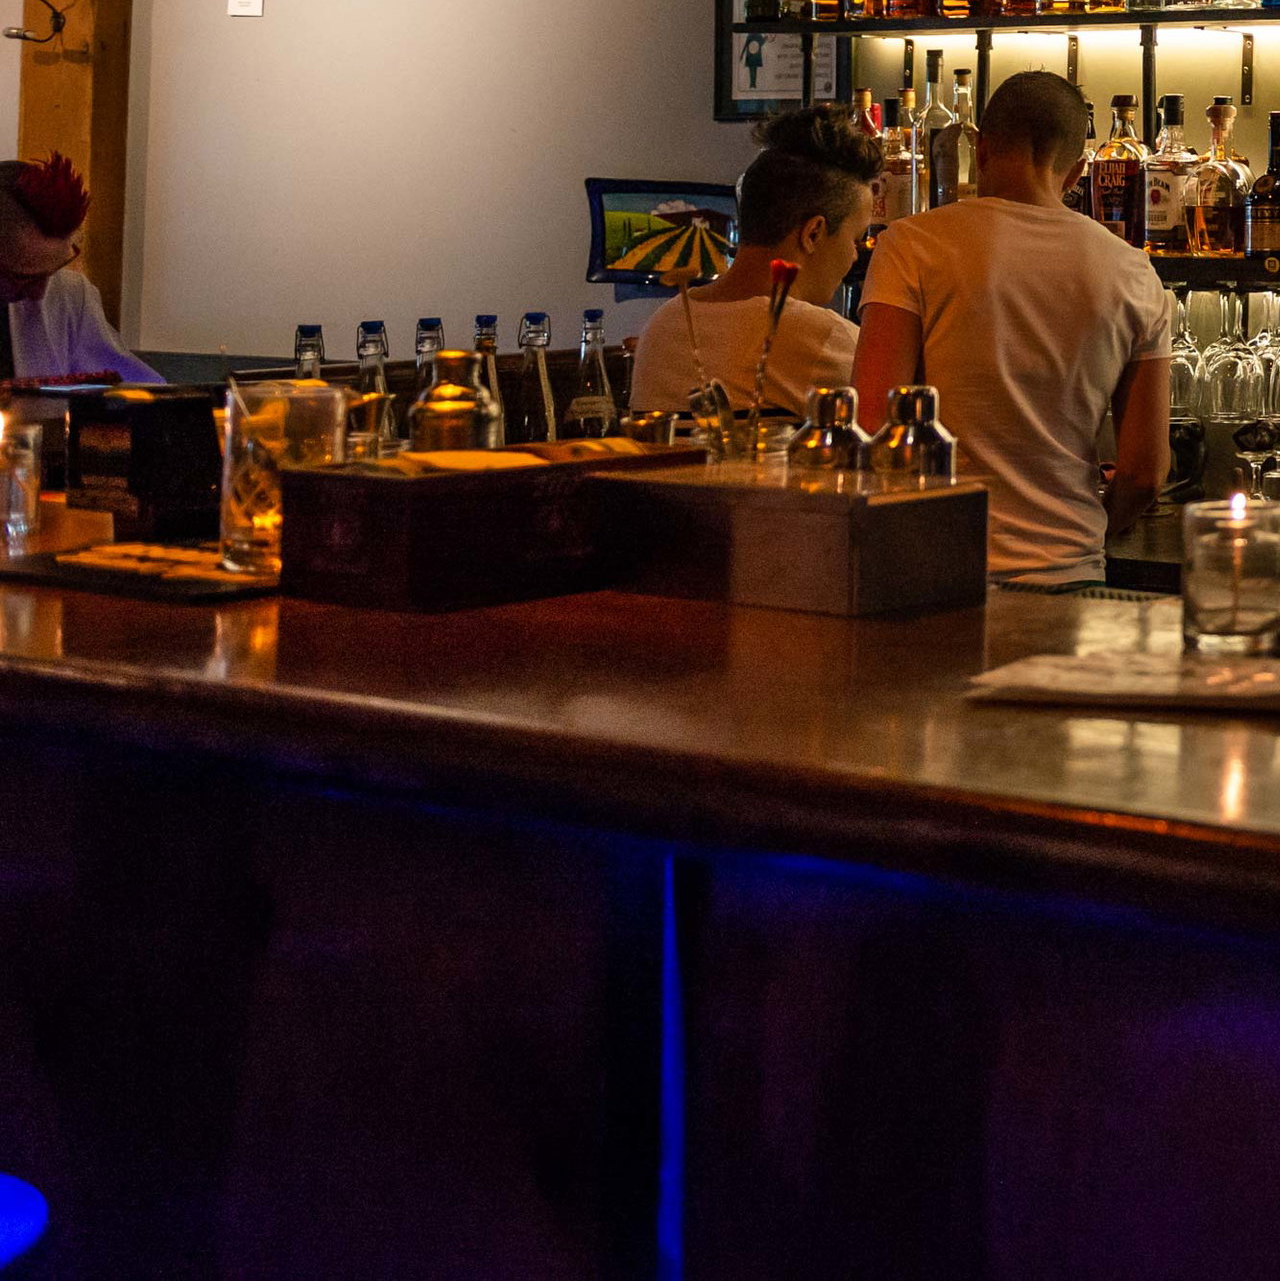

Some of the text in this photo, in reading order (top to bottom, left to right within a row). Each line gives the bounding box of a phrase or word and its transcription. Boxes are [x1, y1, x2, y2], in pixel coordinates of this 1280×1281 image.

[1099, 162, 1126, 174] ELIJAH
[1098, 174, 1126, 187] CRAIG
[1152, 176, 1171, 193] BEAM
